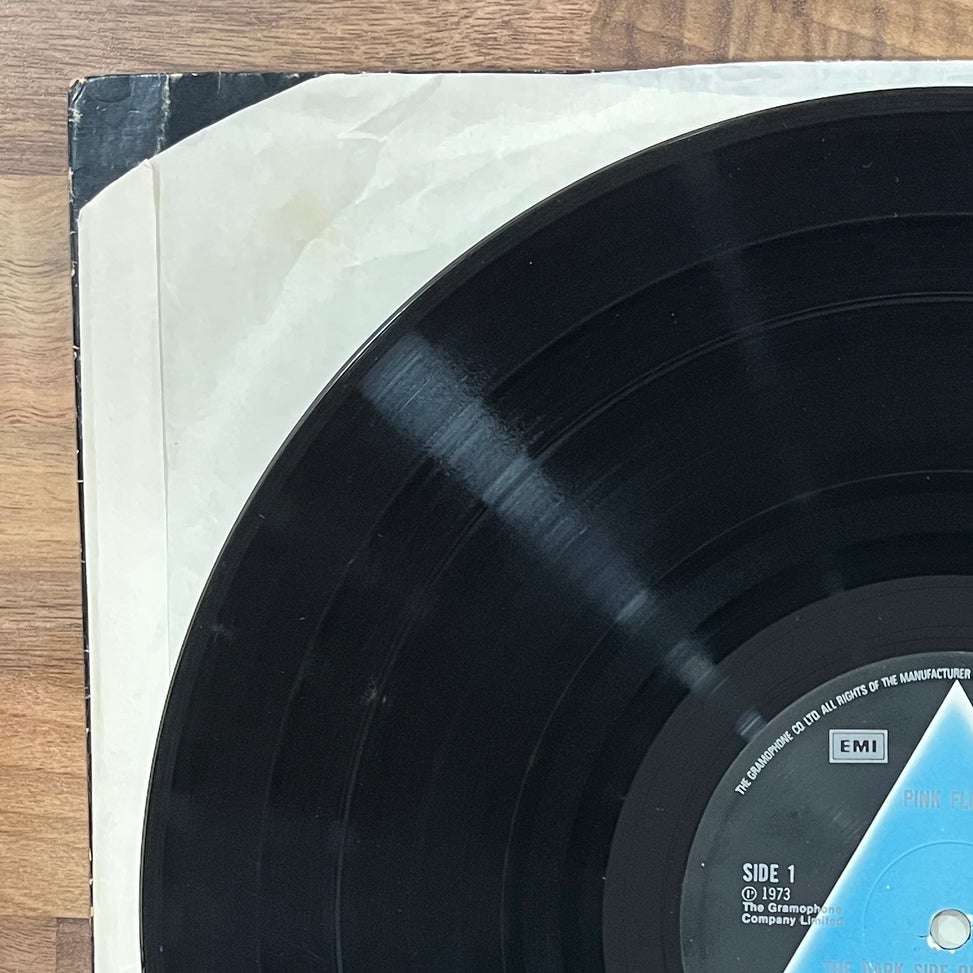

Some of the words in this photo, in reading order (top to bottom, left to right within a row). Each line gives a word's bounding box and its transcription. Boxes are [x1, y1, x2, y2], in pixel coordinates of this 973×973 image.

[735, 777, 751, 795] THE
[747, 731, 794, 781] GRAMOPHONE
[820, 702, 837, 715] ALL
[836, 684, 868, 706] RIGHTS
[869, 681, 880, 693] OF
[881, 675, 898, 688] THE
[900, 668, 970, 683] MANUFACTURER
[841, 740, 876, 753] EMI
[904, 790, 940, 808] PINK
[743, 863, 779, 883] SIDE
[788, 865, 795, 883] 1
[762, 887, 791, 901] 1973
[743, 902, 764, 912] The
[768, 903, 842, 915] Gramophone
[741, 913, 796, 926] Company
